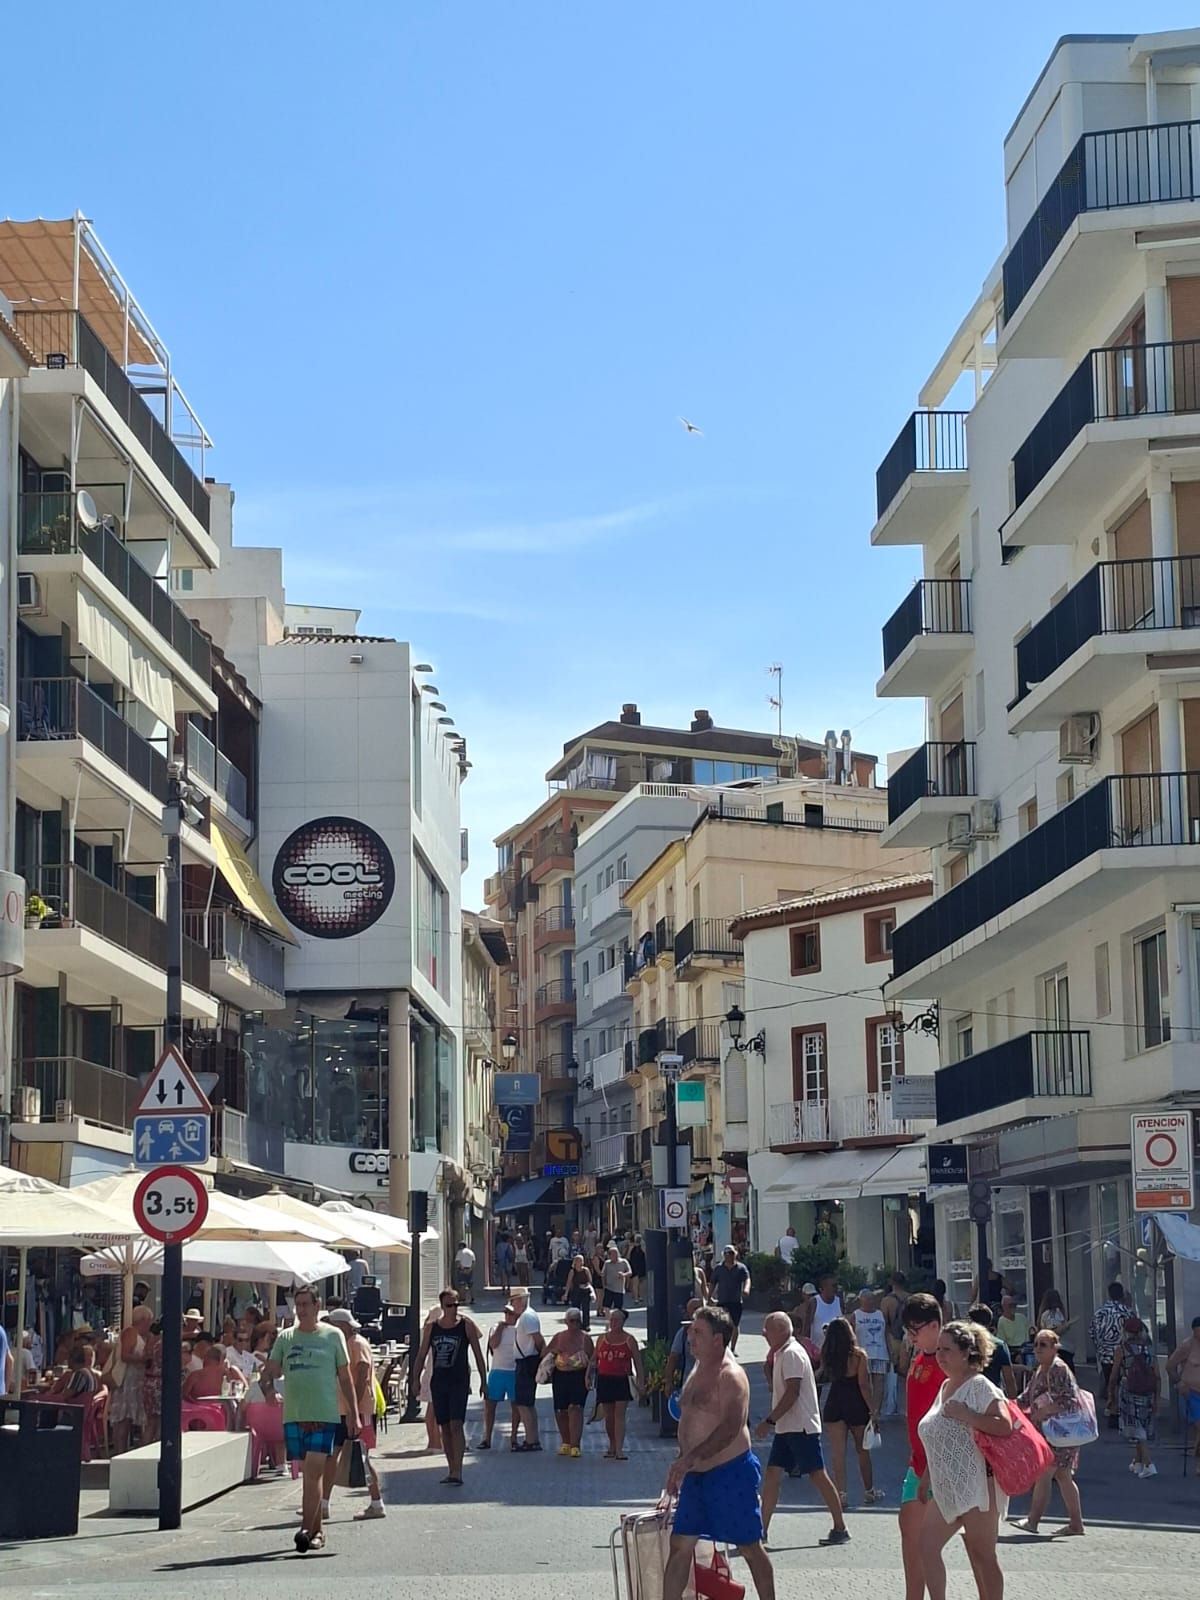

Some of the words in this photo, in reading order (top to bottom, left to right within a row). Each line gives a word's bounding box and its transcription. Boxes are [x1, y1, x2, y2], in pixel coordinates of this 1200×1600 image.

[283, 865, 381, 885] COOL
[344, 889, 384, 900] meeting
[353, 1152, 390, 1173] COO
[145, 1190, 196, 1217] 3,5t
